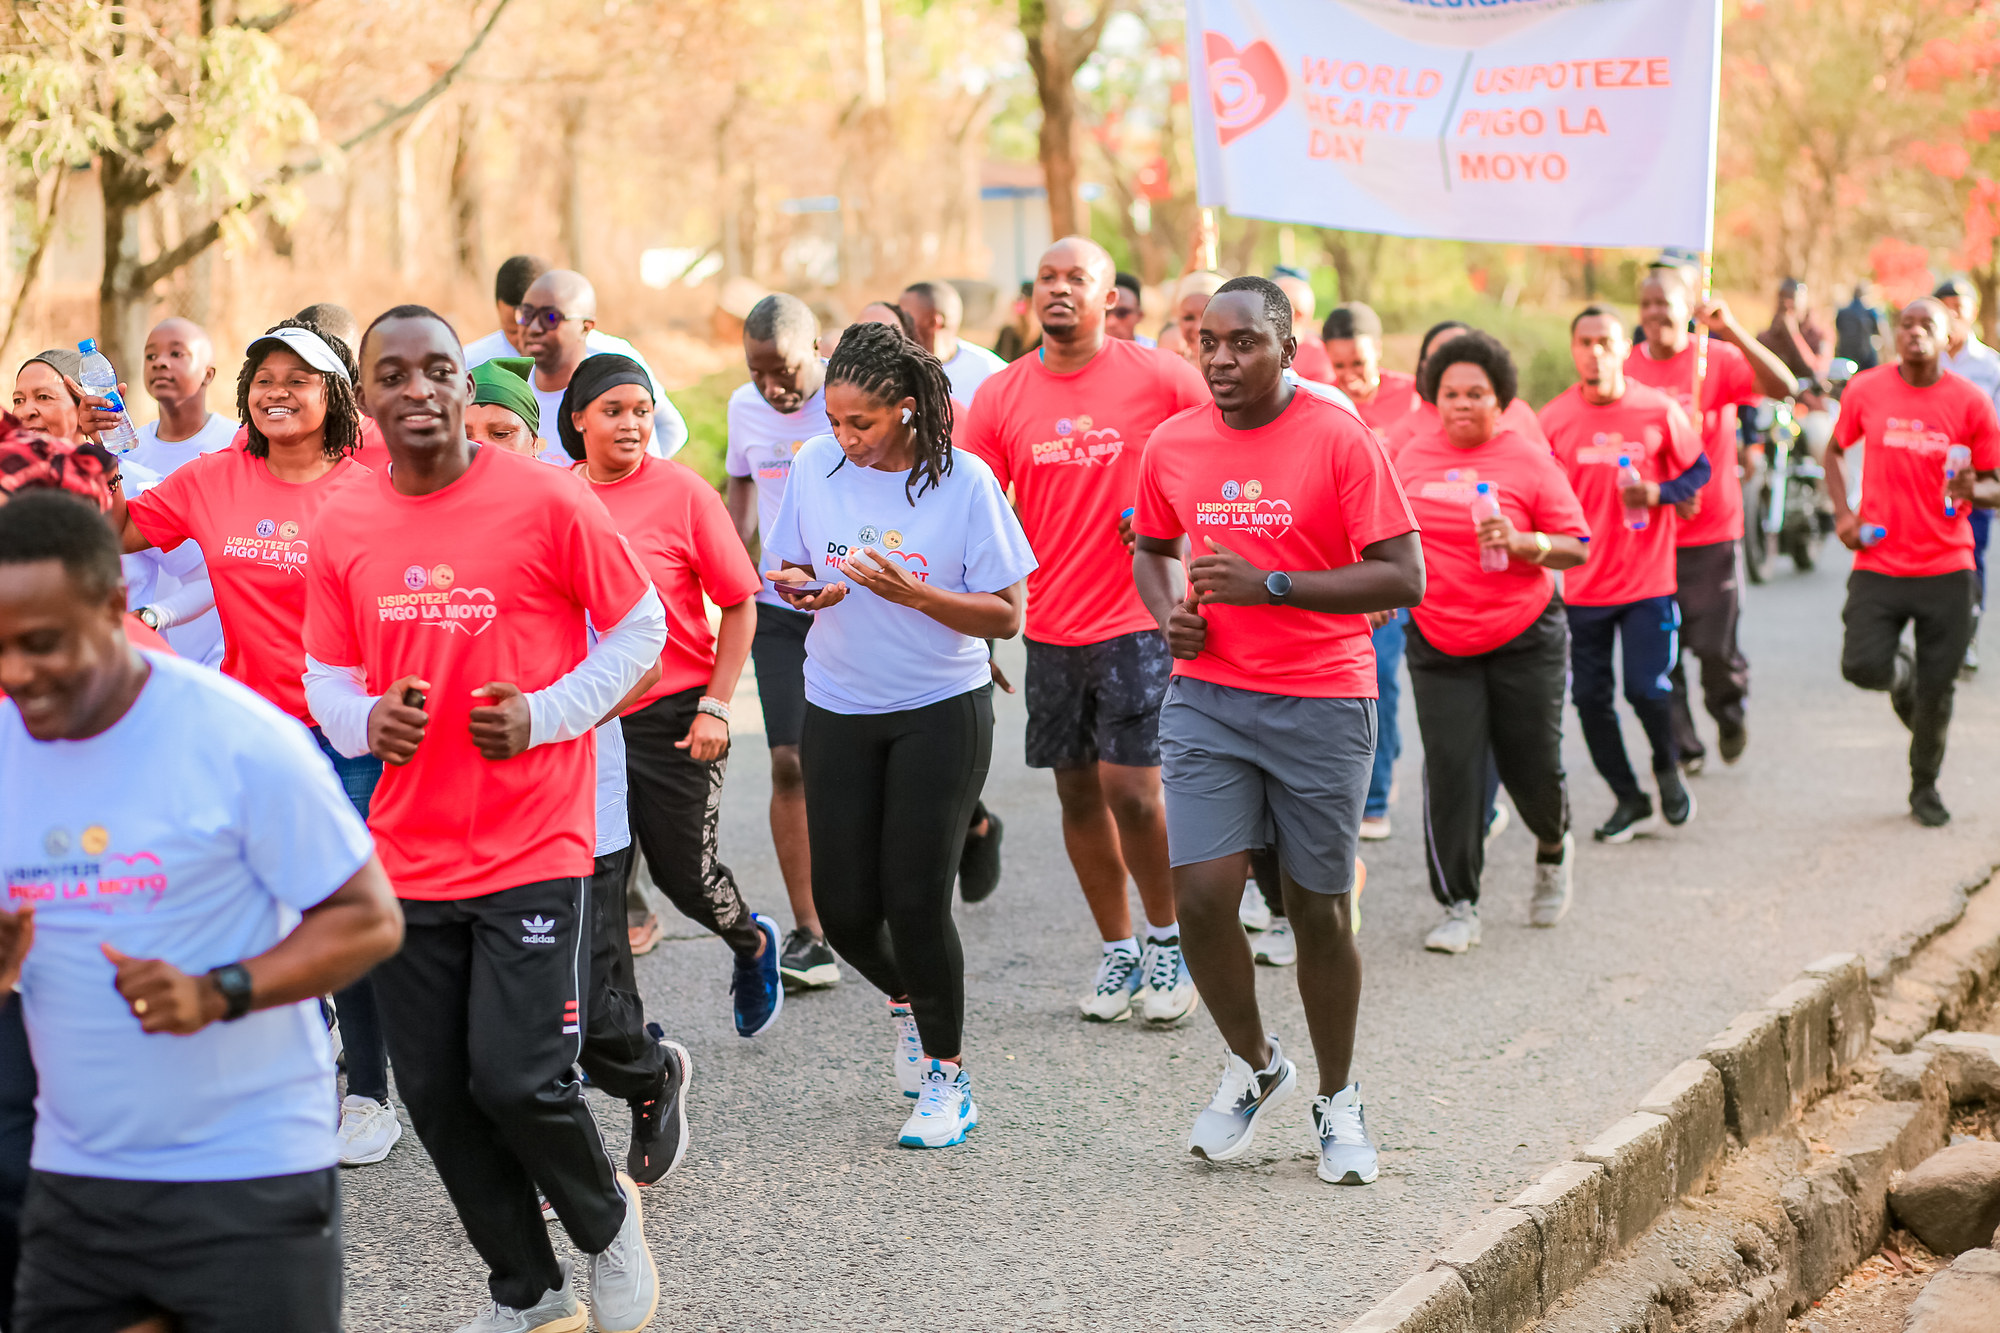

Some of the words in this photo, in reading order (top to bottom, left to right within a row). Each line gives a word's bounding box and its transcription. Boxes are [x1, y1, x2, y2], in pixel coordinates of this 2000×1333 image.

[1302, 55, 1443, 99] WORLD
[1474, 56, 1671, 95] USIPOTEZE
[1303, 93, 1416, 132] HEART
[1458, 106, 1546, 138] PIGO
[1556, 106, 1610, 138] LA
[1307, 128, 1365, 165] DAY
[1458, 152, 1570, 182] MOYO
[1074, 447, 1085, 459] A
[1088, 441, 1124, 457] BEAT
[1196, 502, 1256, 513] USIPOTEZE
[1196, 513, 1229, 525] PIGO
[1232, 513, 1249, 525] LA
[1252, 513, 1293, 526] MOYO
[226, 536, 291, 551] USIPOTEZE
[223, 545, 258, 559] PIGO
[262, 549, 280, 561] LA
[284, 551, 308, 565] MO
[377, 592, 450, 608] USIPOTEZE
[378, 606, 418, 622] PIGO
[421, 605, 442, 619] LA
[445, 604, 497, 619] MOYO
[63, 881, 87, 899] LA
[522, 934, 556, 944] adidas
